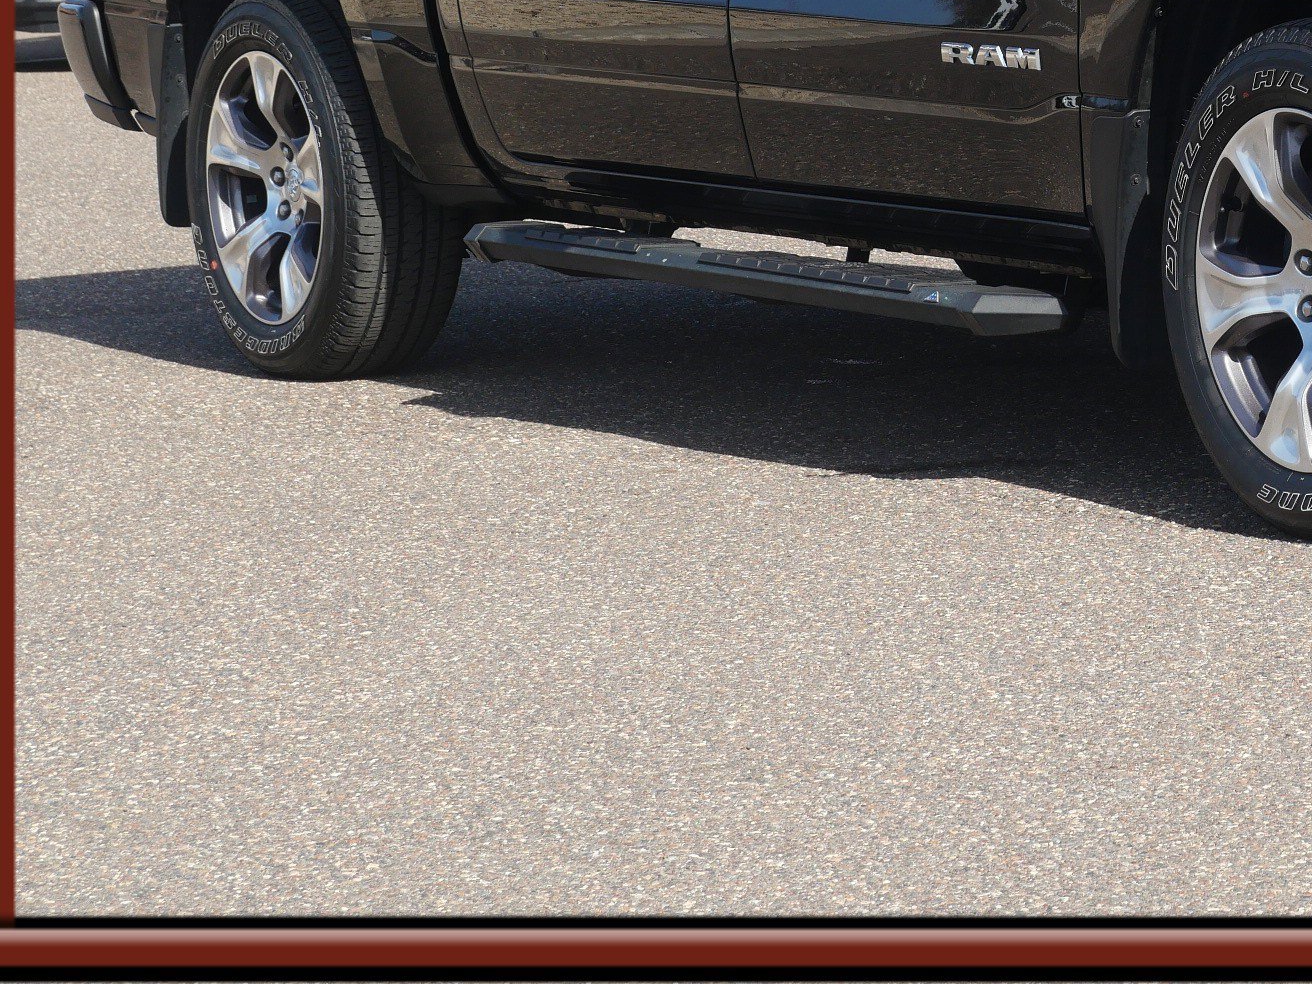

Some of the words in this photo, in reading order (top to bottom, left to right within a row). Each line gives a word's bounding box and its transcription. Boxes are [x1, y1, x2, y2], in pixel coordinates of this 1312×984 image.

[212, 19, 293, 65] DUELER
[940, 41, 1042, 71] RAM
[1164, 84, 1237, 291] DUELER
[1251, 68, 1309, 94] H/L
